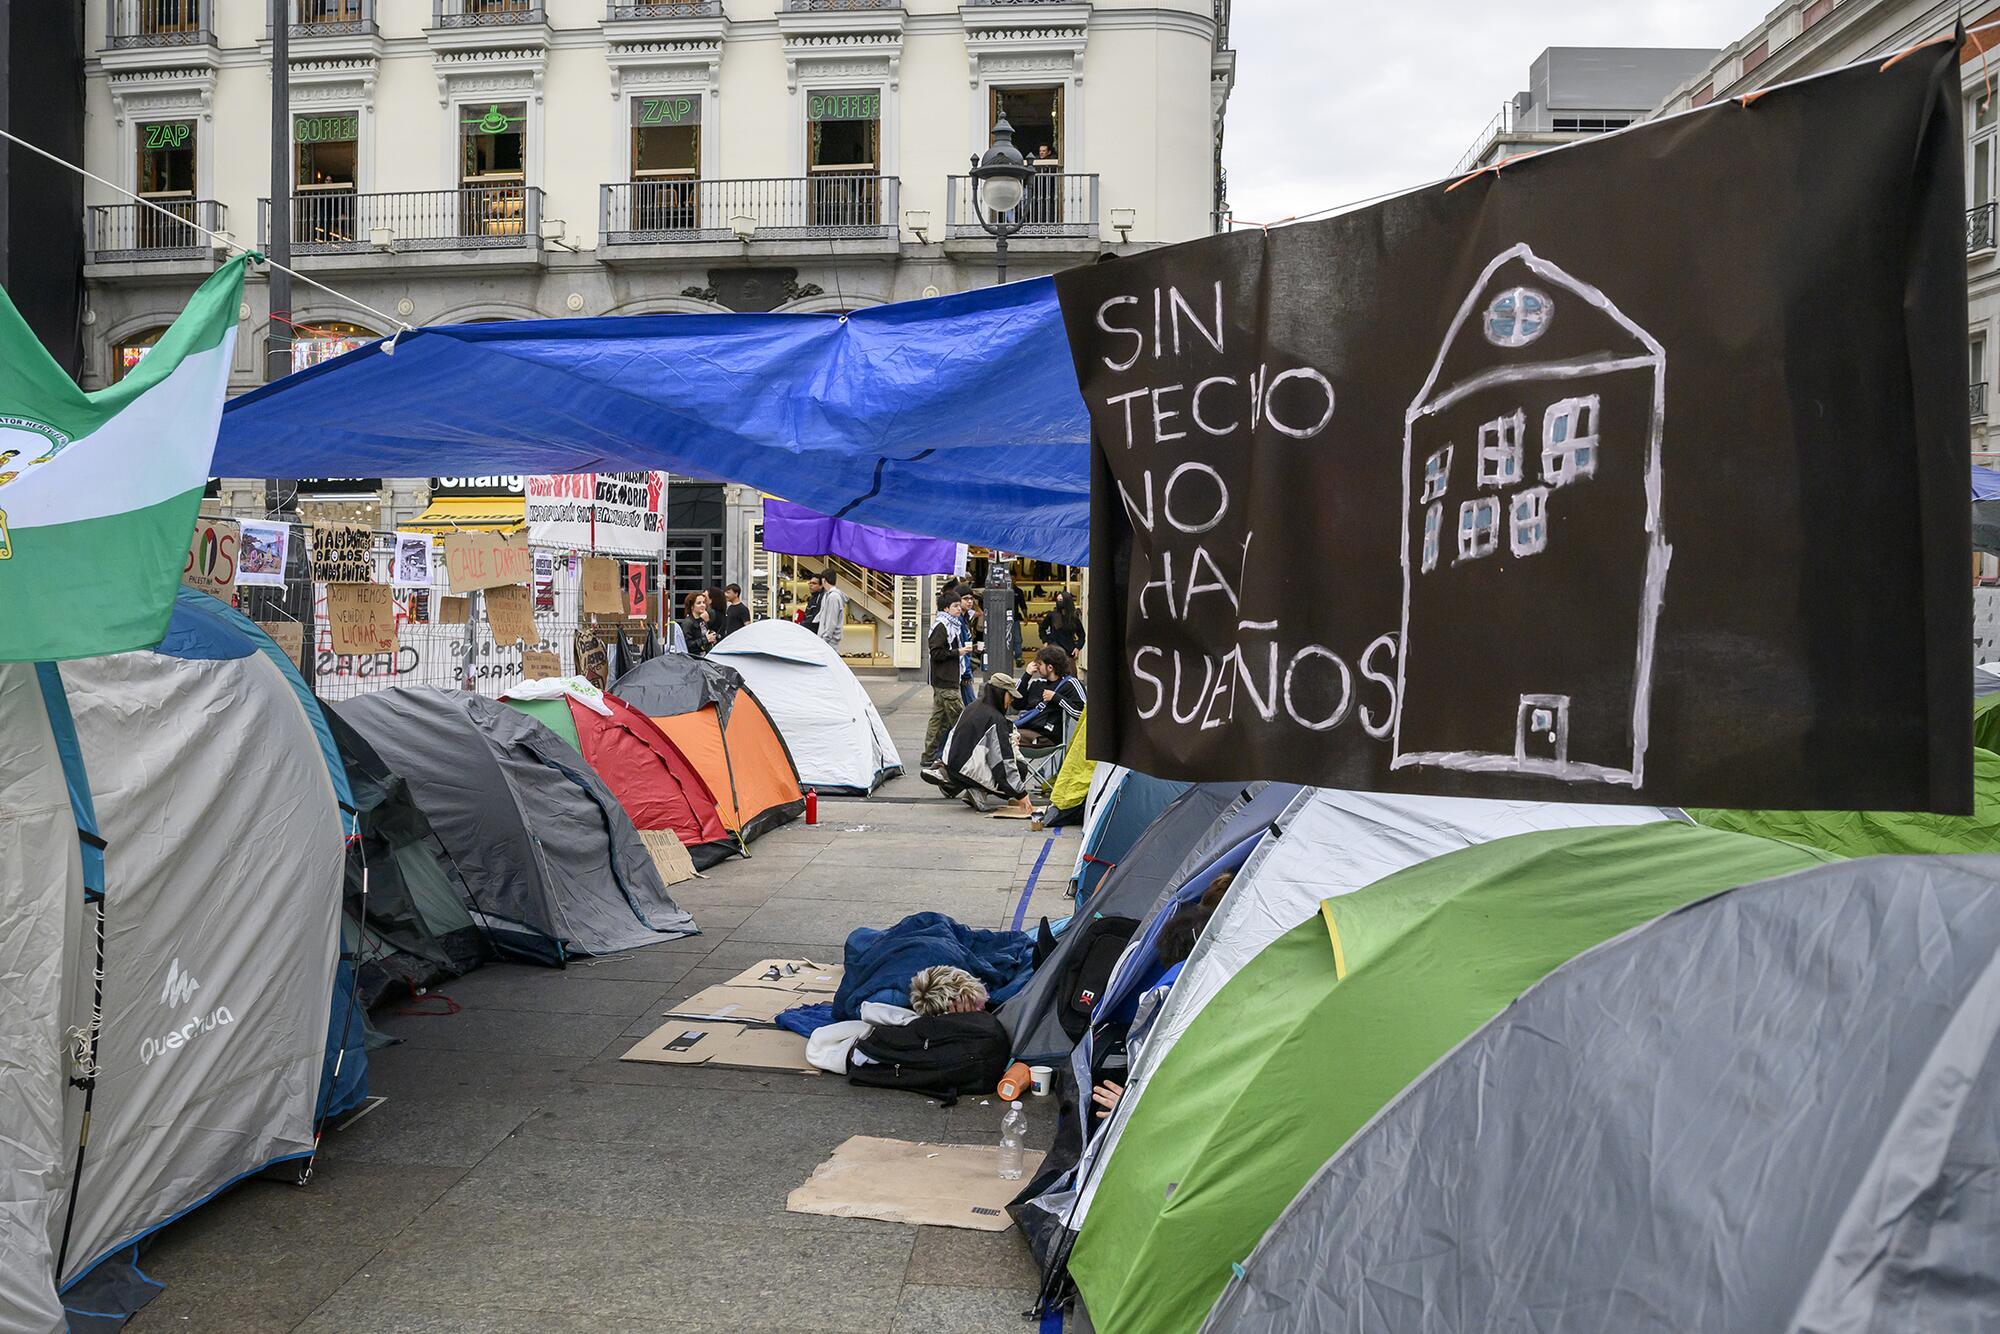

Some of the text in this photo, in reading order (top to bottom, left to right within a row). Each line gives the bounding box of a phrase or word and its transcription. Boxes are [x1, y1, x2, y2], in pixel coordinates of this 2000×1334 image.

[641, 98, 692, 123] ZAP
[808, 94, 880, 120] COFFEE
[146, 124, 190, 149] ZAP
[294, 116, 358, 142] COFFEE
[1096, 280, 1224, 370] SIN
[1106, 363, 1335, 449] TECHO
[618, 484, 648, 508] MORIR
[1117, 461, 1230, 534] NO
[450, 547, 487, 582] CALLE
[357, 588, 387, 604] HEMOS
[368, 609, 376, 623] A
[1132, 620, 1400, 740] SUEÑOS
[140, 1006, 234, 1065] Quechua
